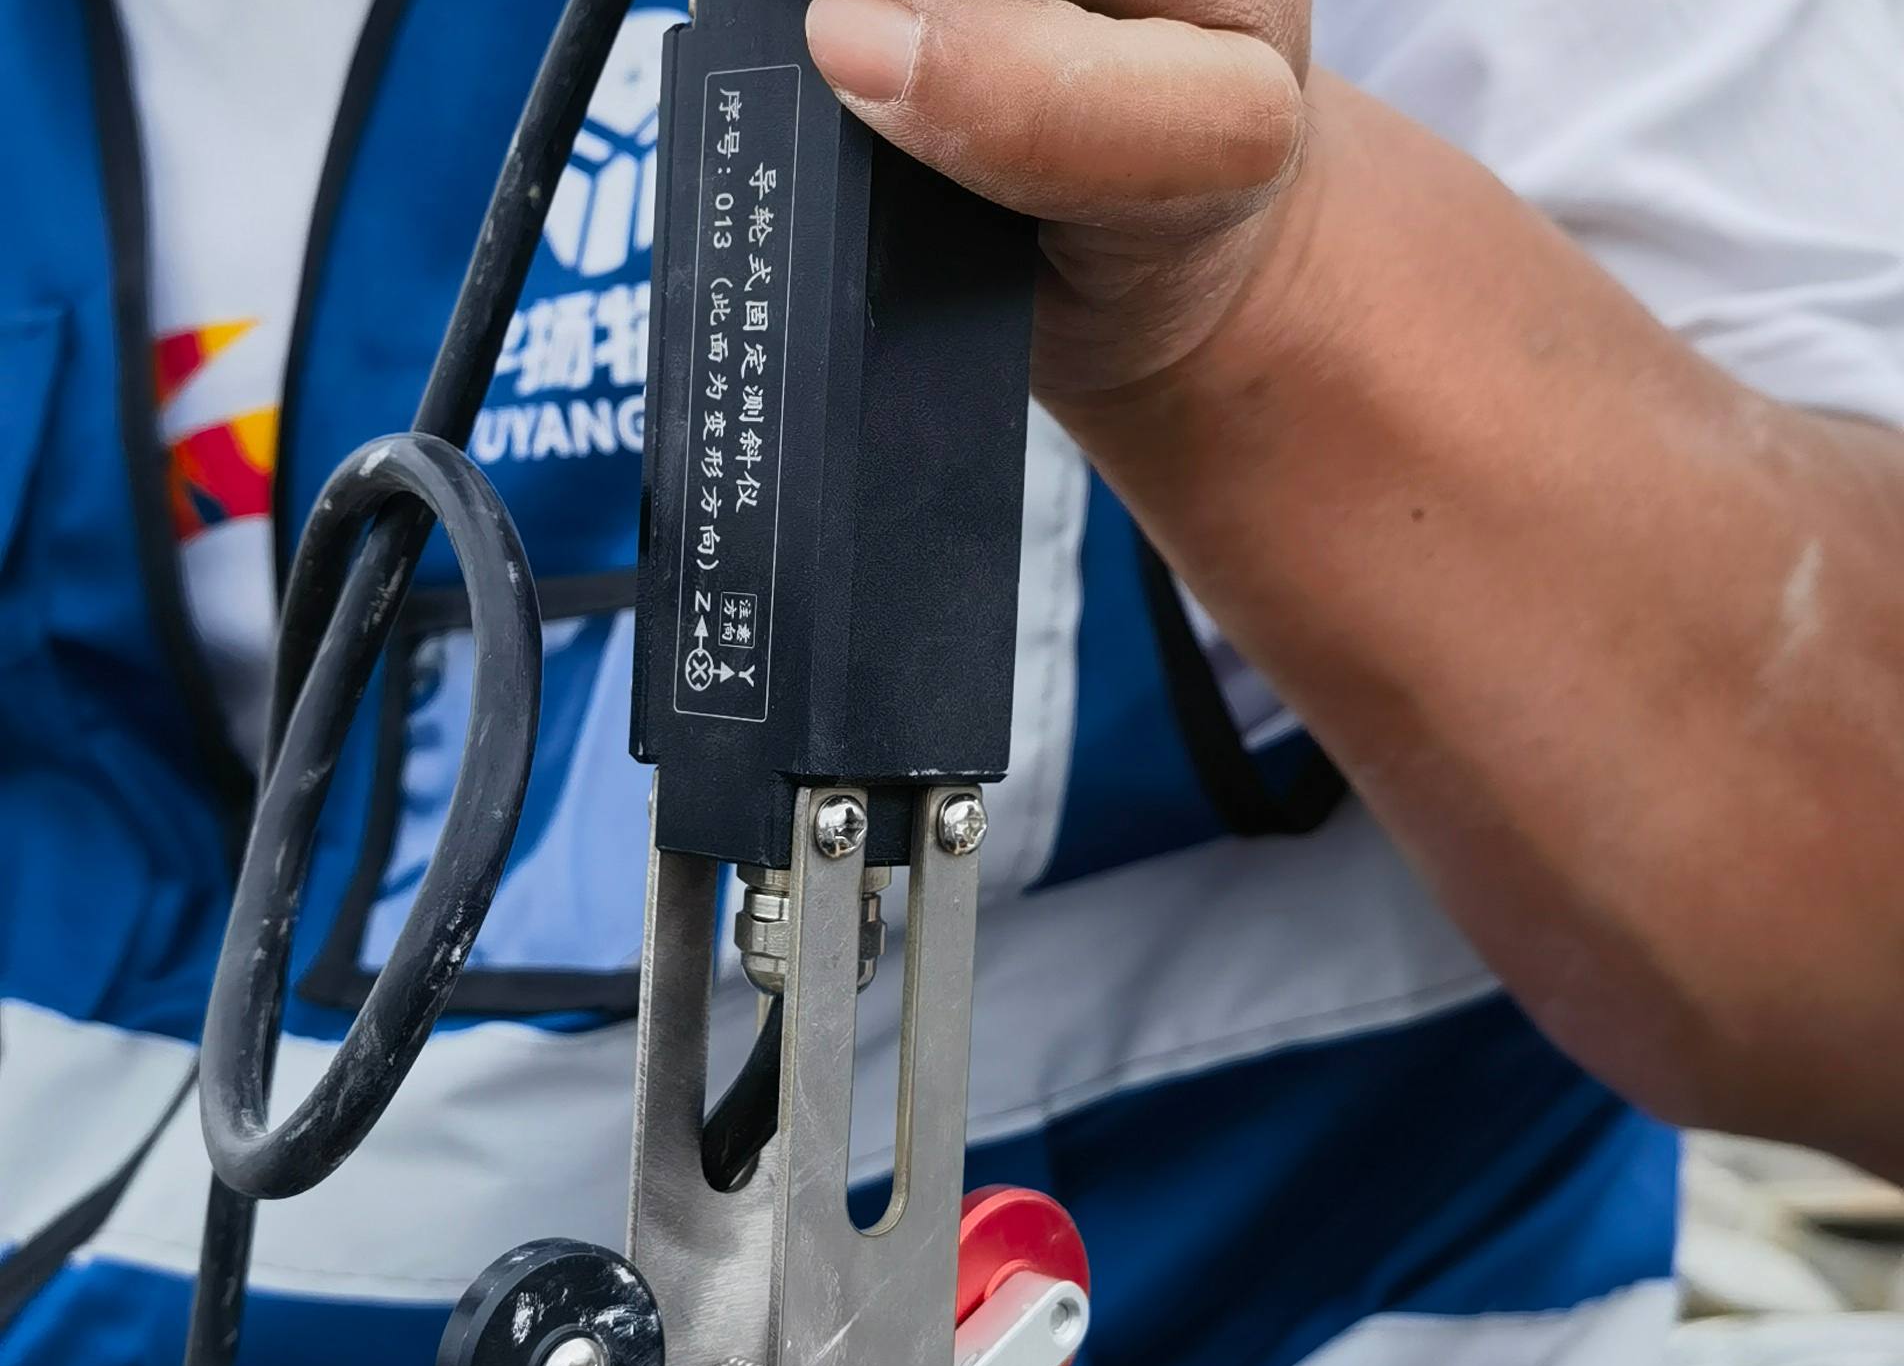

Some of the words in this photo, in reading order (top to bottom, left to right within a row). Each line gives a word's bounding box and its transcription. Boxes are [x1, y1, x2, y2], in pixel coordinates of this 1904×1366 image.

[734, 162, 778, 511] 导轮式固定测斜仪
[721, 598, 737, 641] 方向
[738, 664, 756, 687] Y
